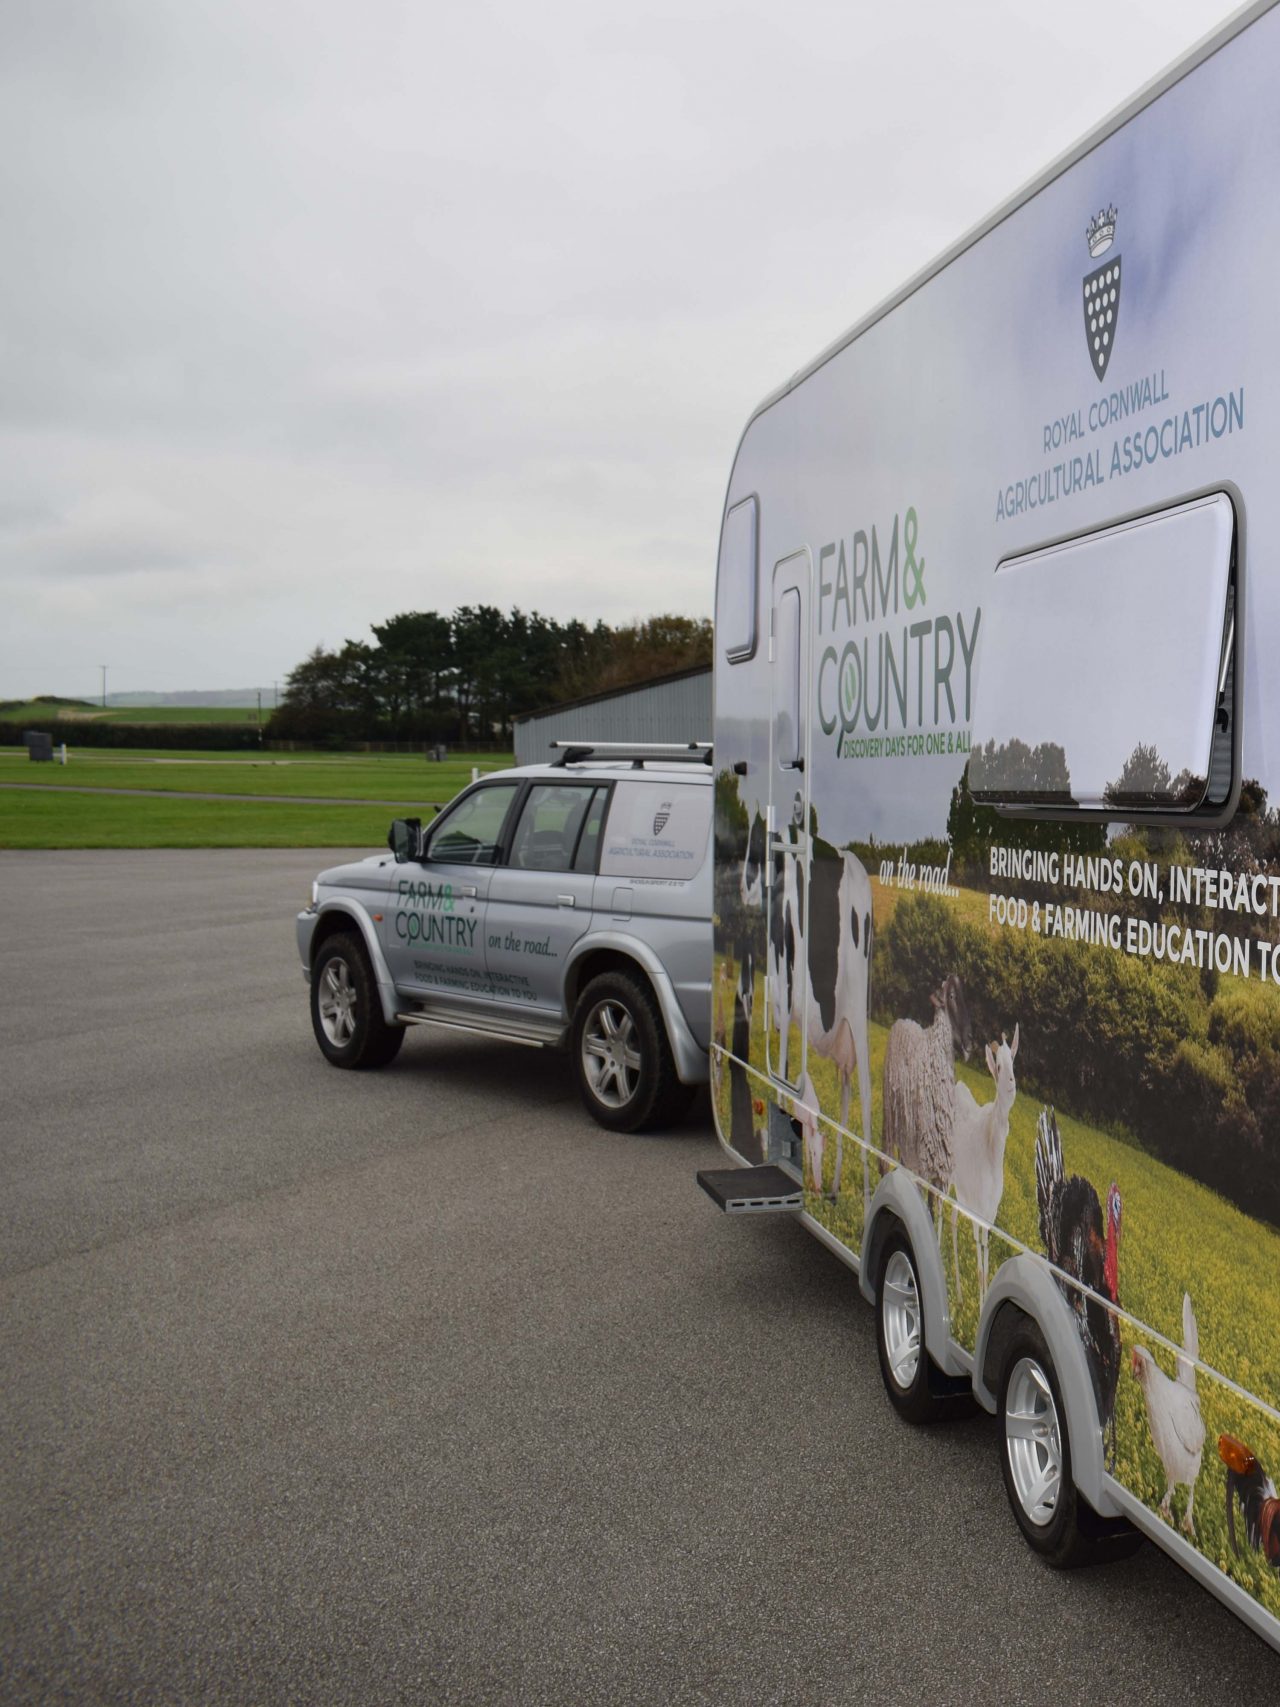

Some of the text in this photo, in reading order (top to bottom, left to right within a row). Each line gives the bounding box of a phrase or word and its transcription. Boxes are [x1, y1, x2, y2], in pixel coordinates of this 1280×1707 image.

[1043, 369, 1169, 454] ROYAL CORNWALL
[995, 387, 1244, 522] AGRICULTURAL ASSOCIATION
[818, 606, 982, 758] COUNTRY
[844, 736, 884, 759] DISCOVERY
[885, 736, 906, 757] DAYS
[907, 734, 924, 756] FOR
[926, 732, 945, 755] ONE
[947, 731, 954, 754] &
[879, 859, 894, 886] on
[897, 847, 916, 891] the
[989, 846, 1059, 885] BRINGING
[1063, 853, 1124, 894] HANDS
[1128, 860, 1164, 905] ON,
[395, 910, 478, 948] COUNTRY
[488, 934, 502, 949] on
[504, 930, 521, 953] the
[989, 893, 1028, 929] FOOD
[1031, 900, 1041, 933] &
[1045, 903, 1121, 950] FARMING
[1126, 917, 1250, 978] EDUCATION
